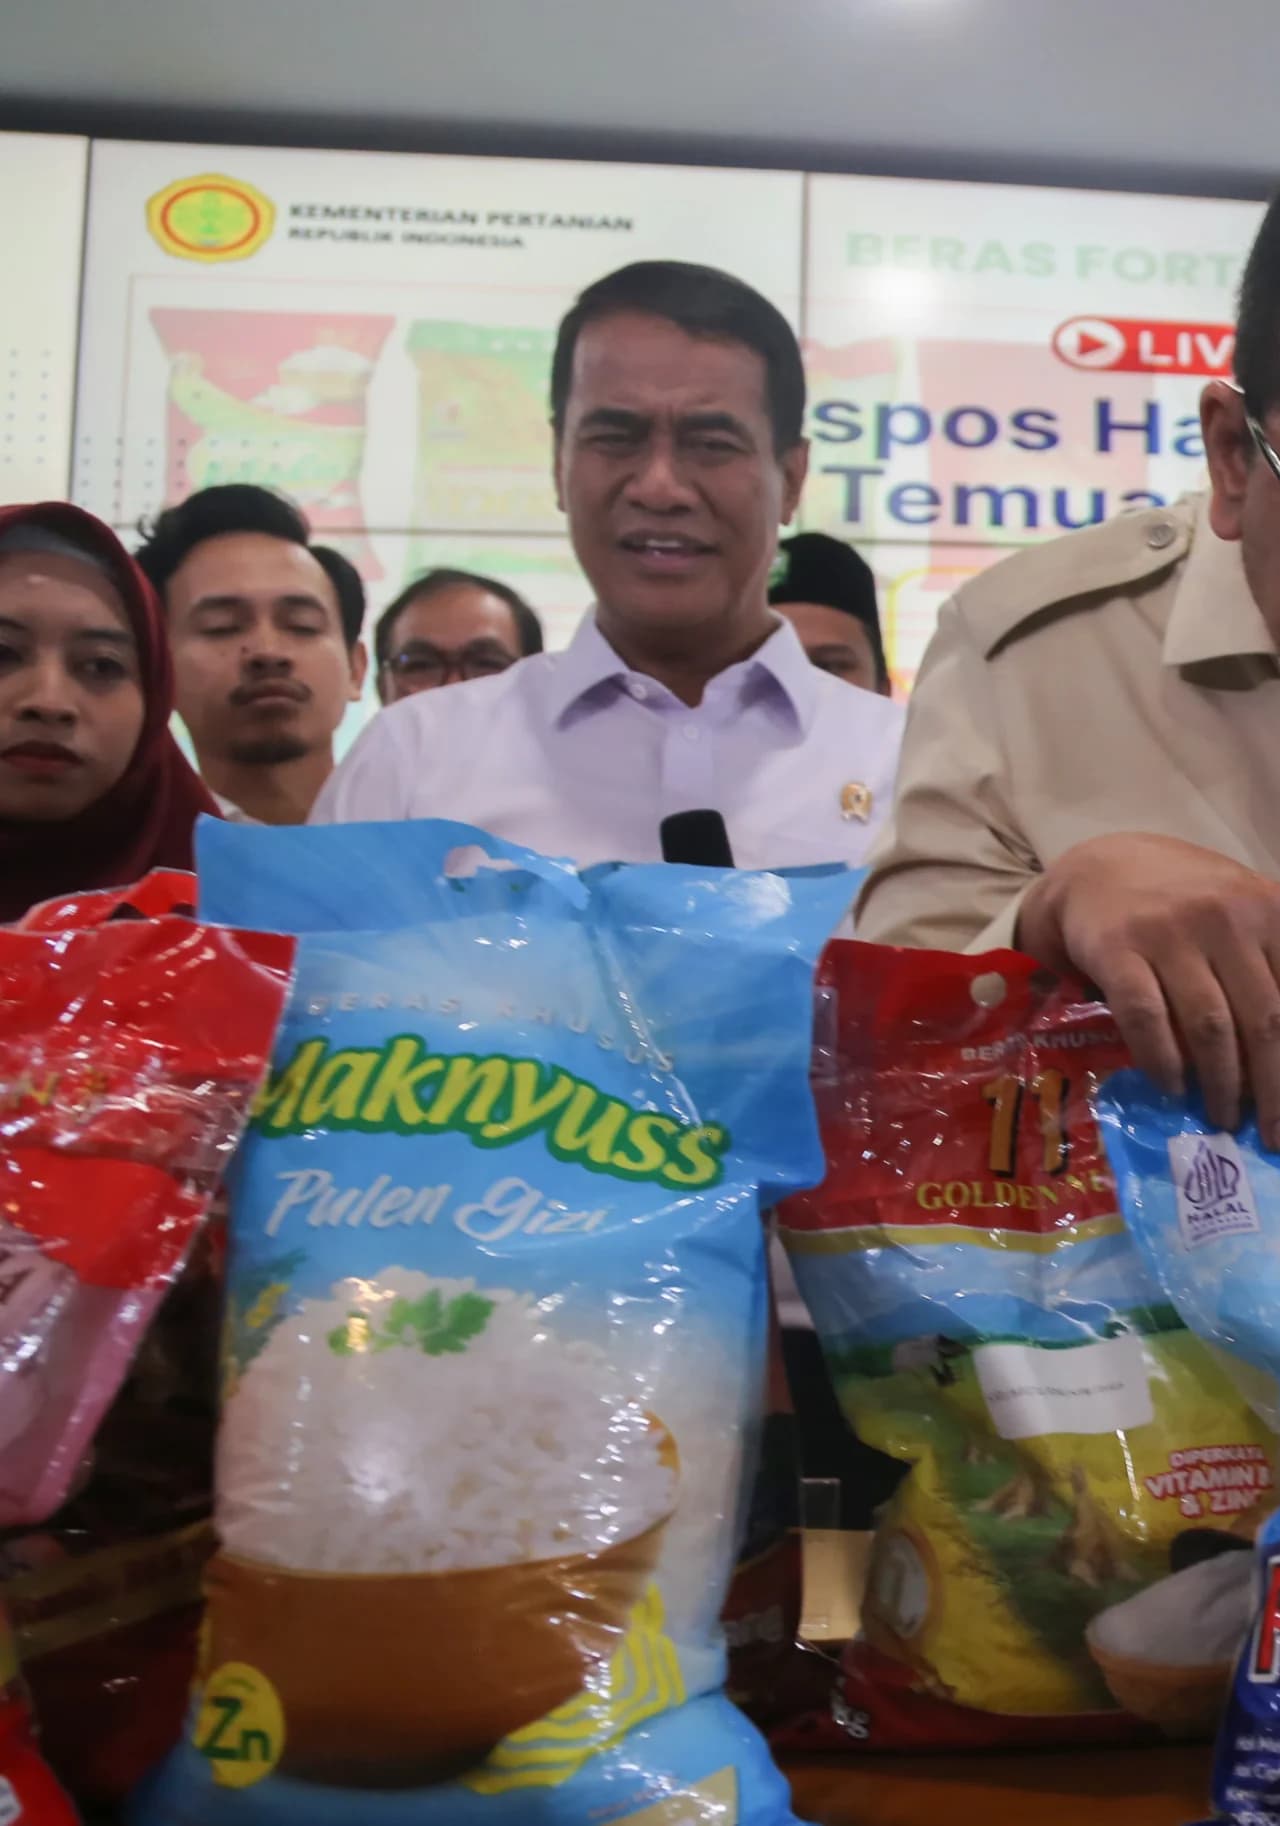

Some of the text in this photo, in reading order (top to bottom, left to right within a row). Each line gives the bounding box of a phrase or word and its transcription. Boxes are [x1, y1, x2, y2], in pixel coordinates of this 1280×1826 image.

[289, 203, 634, 232] KEMENTERIAN PERTANIAN
[288, 227, 526, 249] REPUBLIK INDONESIA
[846, 231, 1058, 280] BERAS
[1074, 244, 1239, 288] FORT
[1138, 329, 1237, 369] LIV
[811, 398, 1060, 461] spos
[1095, 396, 1207, 458] Ha
[262, 1168, 455, 1239] Pulen
[916, 1180, 1058, 1211] GOLDEN
[1144, 1465, 1255, 1498] VITAMIN
[200, 1696, 272, 1763] Zn
